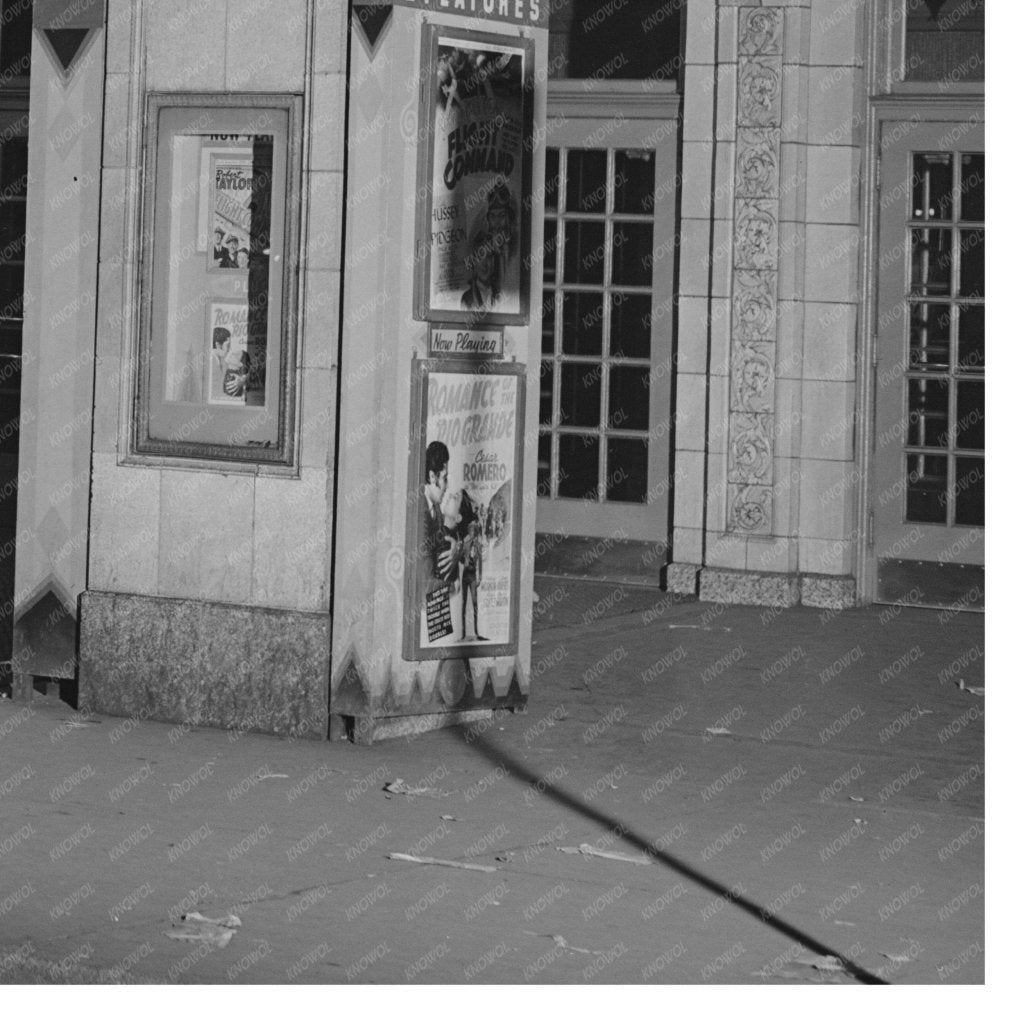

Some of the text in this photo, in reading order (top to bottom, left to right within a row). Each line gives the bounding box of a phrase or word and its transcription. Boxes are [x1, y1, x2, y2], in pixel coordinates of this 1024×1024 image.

[432, 331, 497, 353] Now Playing
[428, 377, 500, 416] ROMANCE
[463, 462, 507, 482] ROMERO
